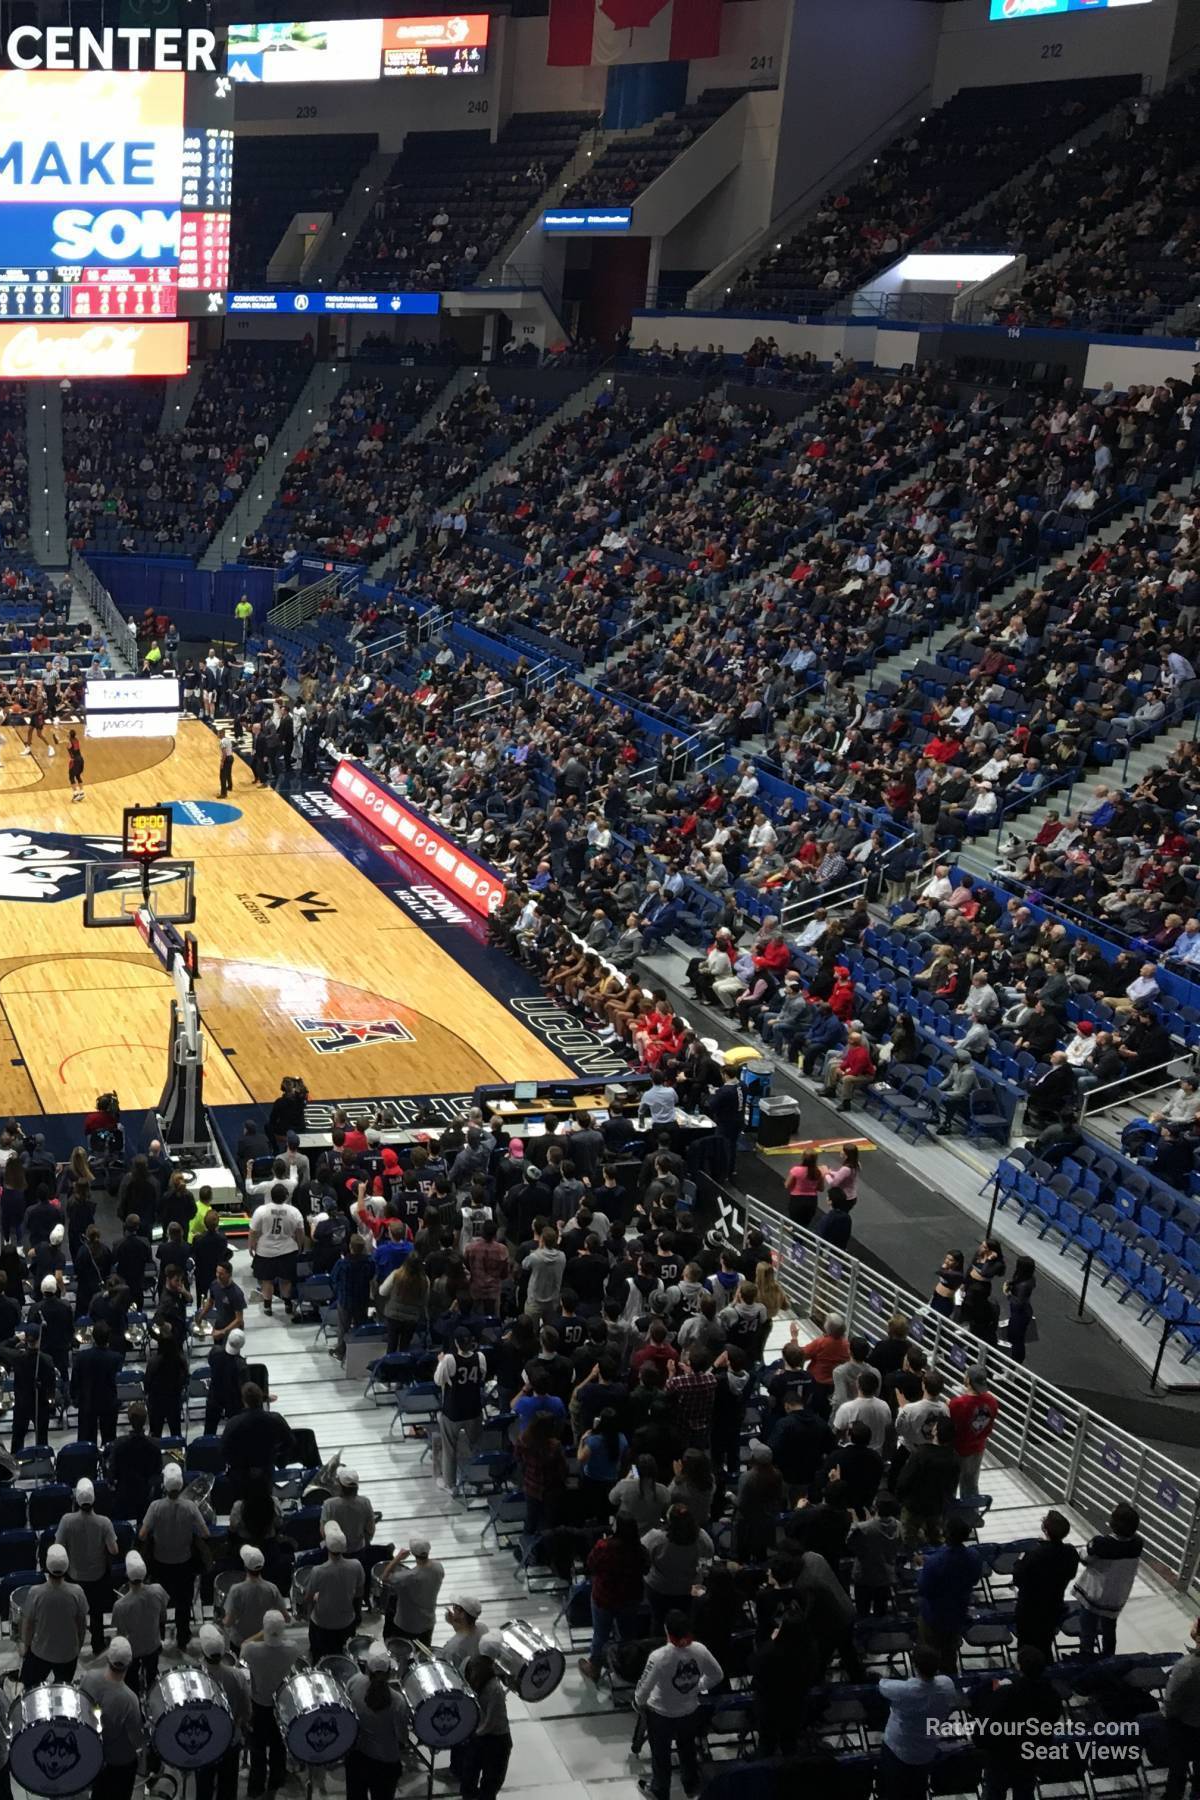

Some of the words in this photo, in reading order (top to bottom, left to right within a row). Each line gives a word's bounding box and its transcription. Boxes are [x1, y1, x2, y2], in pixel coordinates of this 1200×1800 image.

[7, 26, 216, 71] CENTER
[1041, 44, 1062, 58] 212
[750, 56, 773, 69] 241
[296, 106, 317, 118] 239
[467, 100, 488, 113] 240
[51, 209, 181, 260] SOM
[290, 794, 322, 817] HEALTH
[305, 791, 352, 819] UCONN
[133, 830, 161, 852] 22
[242, 901, 271, 925] CENTER
[394, 890, 436, 920] HEALTH
[410, 885, 472, 923] UCONN
[406, 1200, 419, 1215] 15
[271, 1218, 282, 1235] 15
[661, 1264, 677, 1279] 50
[565, 1326, 582, 1343] 50
[740, 1320, 757, 1334] 34
[458, 1366, 478, 1385] 34
